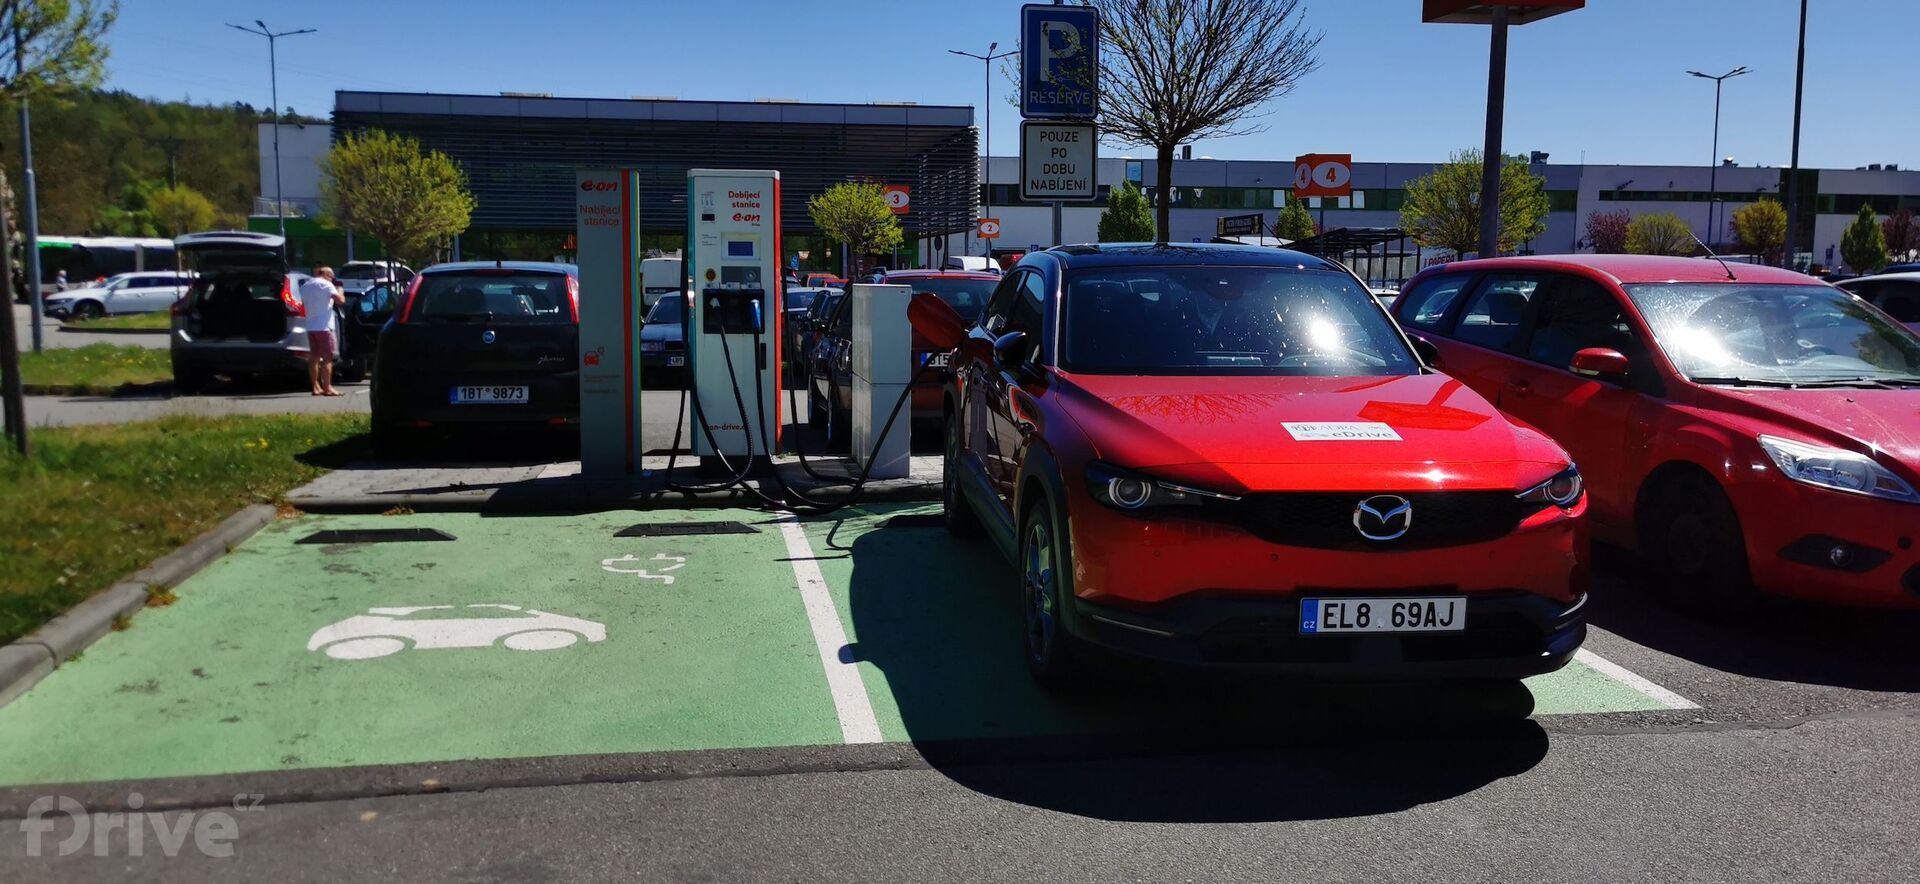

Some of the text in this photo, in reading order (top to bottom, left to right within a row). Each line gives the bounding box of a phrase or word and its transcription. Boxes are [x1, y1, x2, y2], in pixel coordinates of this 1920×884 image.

[1040, 20, 1081, 82] P
[1040, 131, 1079, 143] POUZE
[1051, 147, 1067, 158] PO
[1043, 163, 1076, 175] DOBU
[1325, 167, 1337, 183] 4
[1300, 168, 1306, 183] 4
[1031, 177, 1087, 191] NABÍJENÍ
[732, 201, 761, 209] stanice
[892, 194, 901, 204] 3
[583, 216, 620, 226] stanice
[987, 224, 993, 232] 2
[461, 387, 523, 400] 1BT 9873
[1303, 601, 1454, 630] CZ EL8 69AJ
